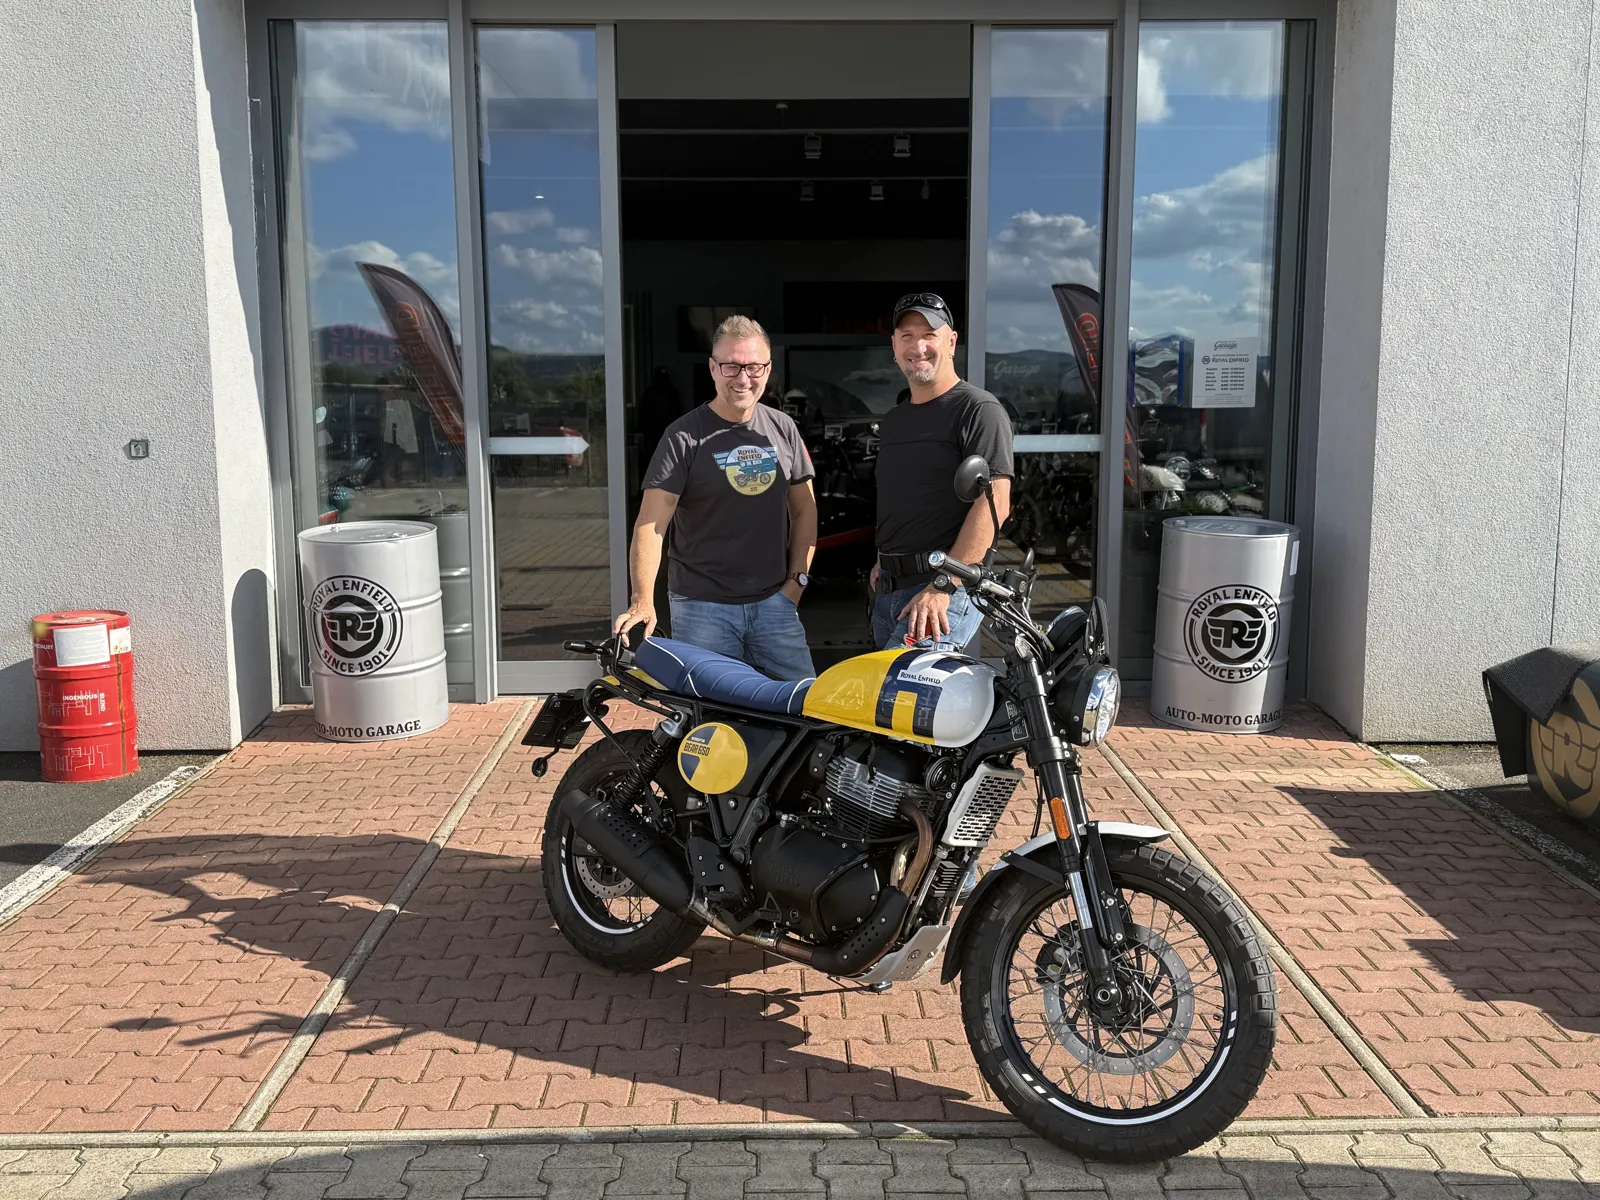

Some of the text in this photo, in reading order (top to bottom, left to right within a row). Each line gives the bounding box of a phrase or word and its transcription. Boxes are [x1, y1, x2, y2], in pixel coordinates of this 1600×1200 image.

[994, 360, 1040, 380] Garage
[737, 453, 762, 461] ENFIELD
[312, 580, 394, 612] ROYAL ENFIELD
[1192, 589, 1276, 620] ROYAL ENFIELD
[322, 650, 389, 673] SINCE 1901
[1197, 656, 1266, 679] SINCE 1901
[900, 671, 941, 684] ROYAL ENFIELD
[1165, 706, 1242, 726] AUTO-MOTO
[315, 719, 421, 738] TO-MOTO GARAGE
[684, 742, 711, 756] BEAR 650
